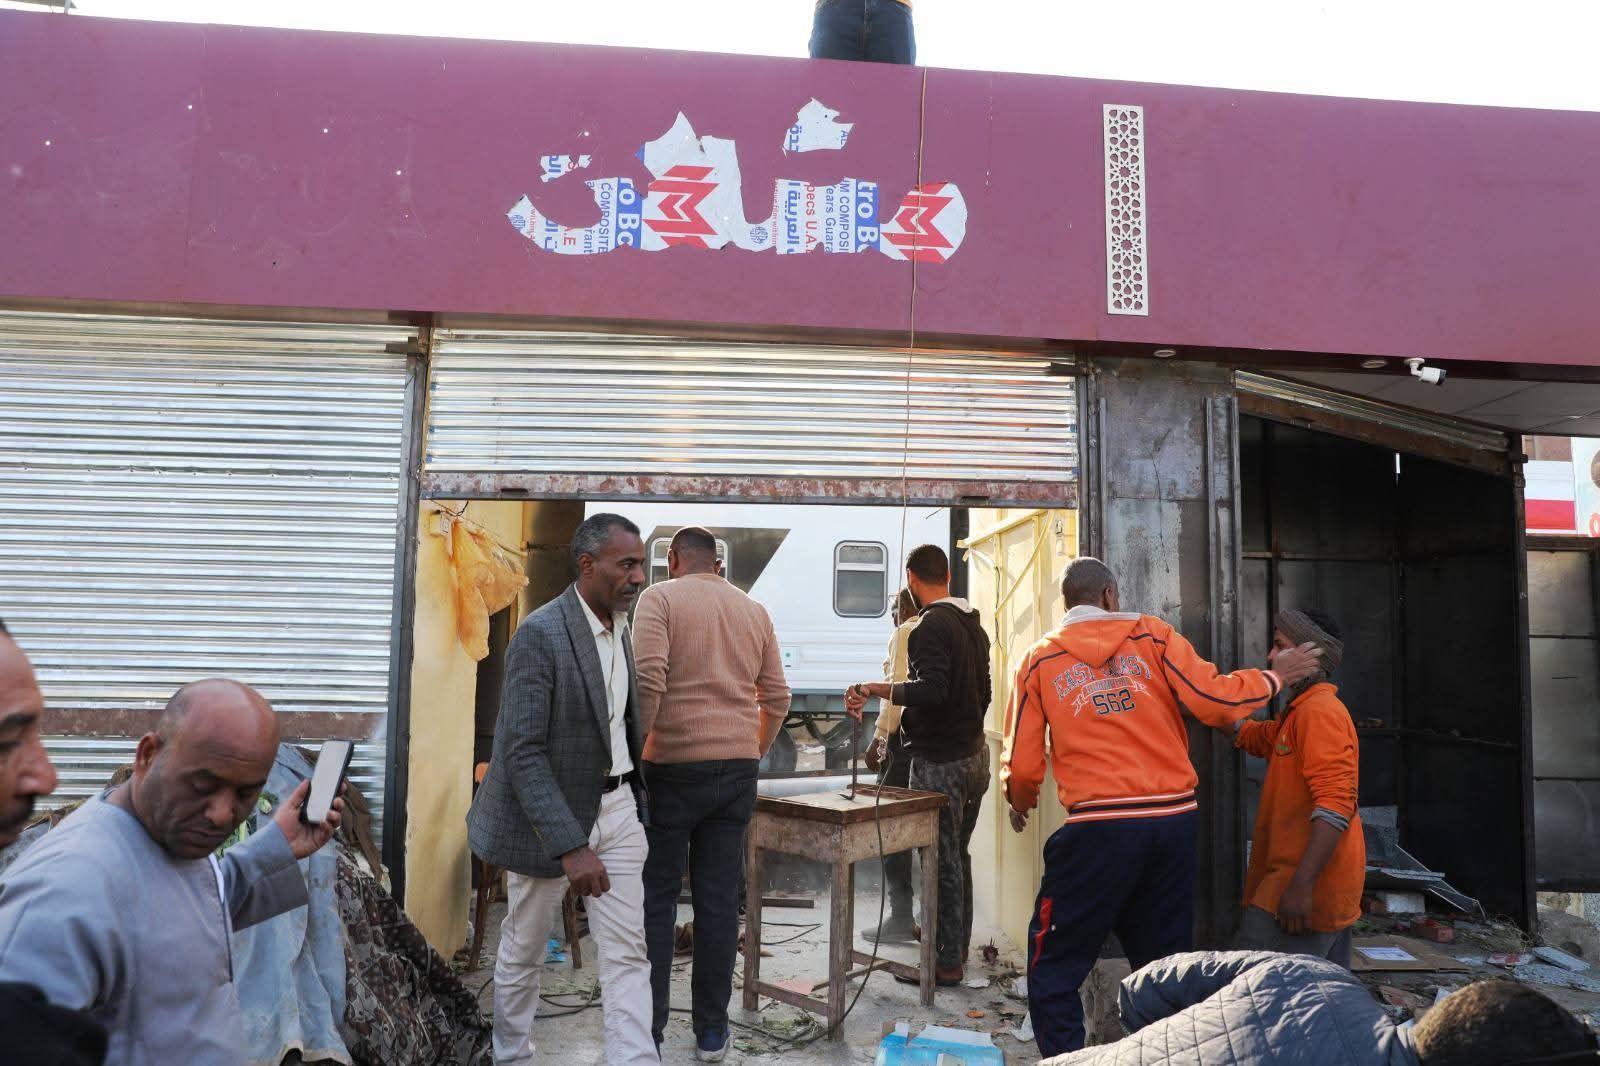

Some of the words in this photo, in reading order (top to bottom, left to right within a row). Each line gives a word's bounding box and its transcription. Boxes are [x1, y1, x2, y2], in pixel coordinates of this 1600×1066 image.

[785, 190, 801, 244] العربية
[857, 182, 878, 220] tro
[1092, 688, 1135, 715] 562
